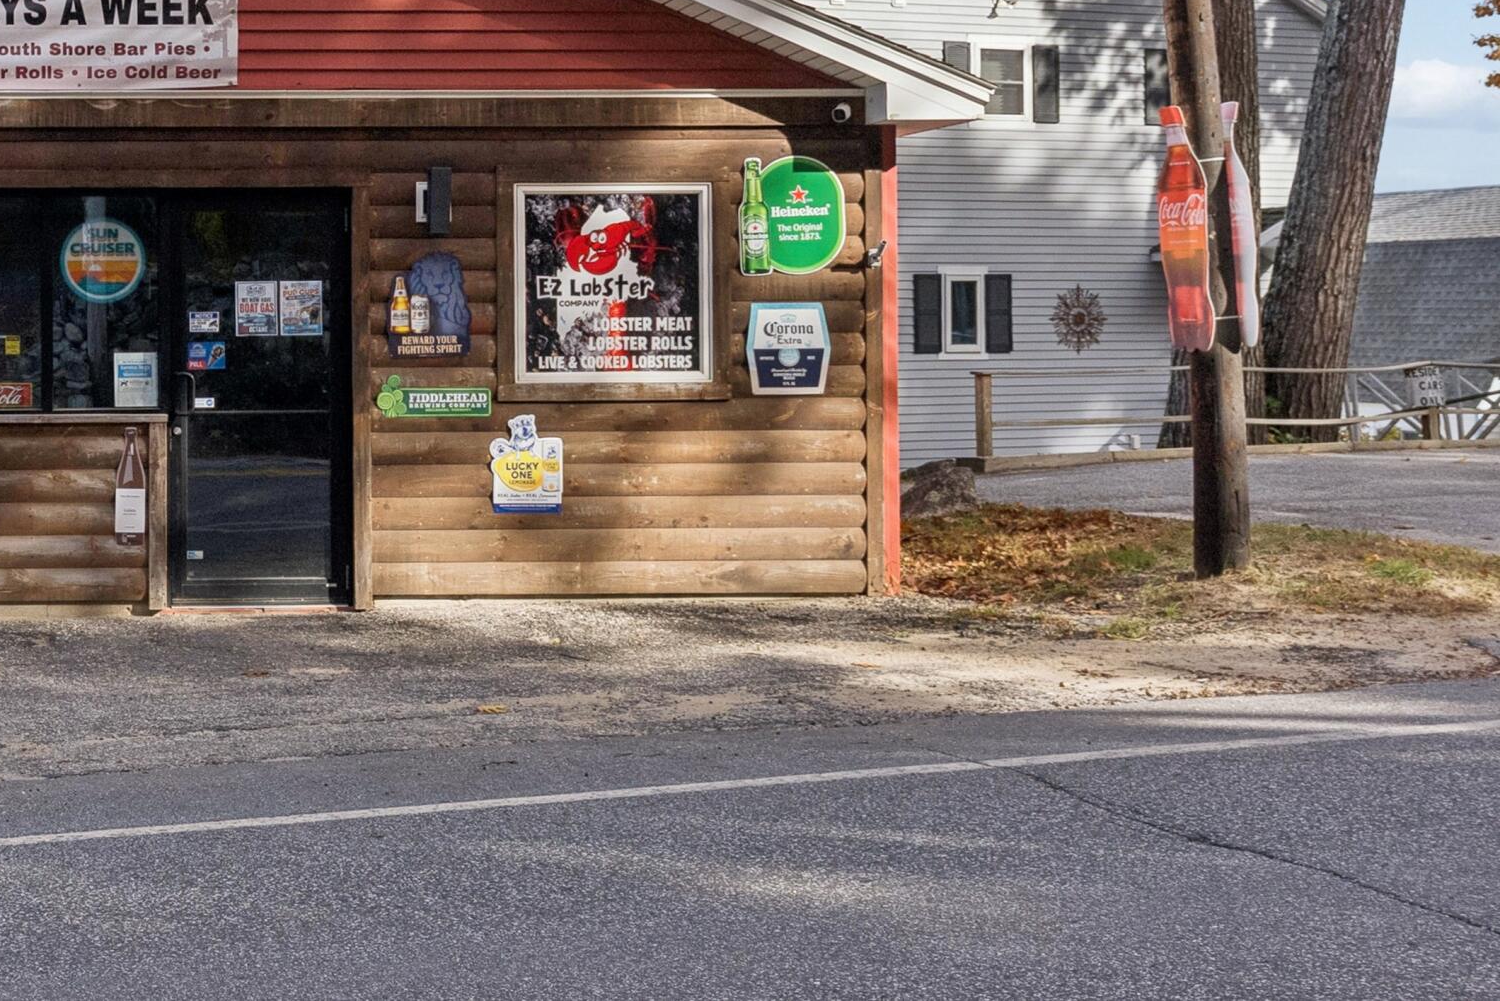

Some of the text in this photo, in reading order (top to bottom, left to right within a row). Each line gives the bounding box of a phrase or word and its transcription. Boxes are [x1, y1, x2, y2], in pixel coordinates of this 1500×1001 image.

[50, 42, 106, 56] Shore
[114, 42, 148, 56] Bar
[154, 42, 196, 56] Pies
[15, 66, 64, 79] Rolls
[86, 66, 117, 79] Ice
[125, 65, 168, 79] Cold
[175, 66, 221, 79] Beer
[771, 204, 829, 217] Heineken
[777, 222, 823, 232] The Original
[88, 228, 119, 241] SUN
[779, 233, 799, 241] since
[70, 242, 137, 256] CRUISER
[240, 303, 274, 313] BOAT GAS
[559, 300, 600, 308] COMPANY
[594, 317, 693, 331] LOBSTER MEAT
[763, 321, 814, 337] Corona
[402, 335, 458, 345] REWARD YOUR
[588, 336, 693, 350] LOBSTER ROLLS
[777, 335, 802, 344] Extra
[397, 344, 463, 355] FIGHTING SPIRIT
[538, 355, 693, 369] LIVE & COOKED LOBSTERS
[1419, 380, 1445, 391] CARS
[409, 393, 487, 403] FIDDLEHEAD
[1420, 396, 1445, 406] ONLY
[506, 462, 539, 471] LUCKY
[511, 471, 533, 480] ONE
